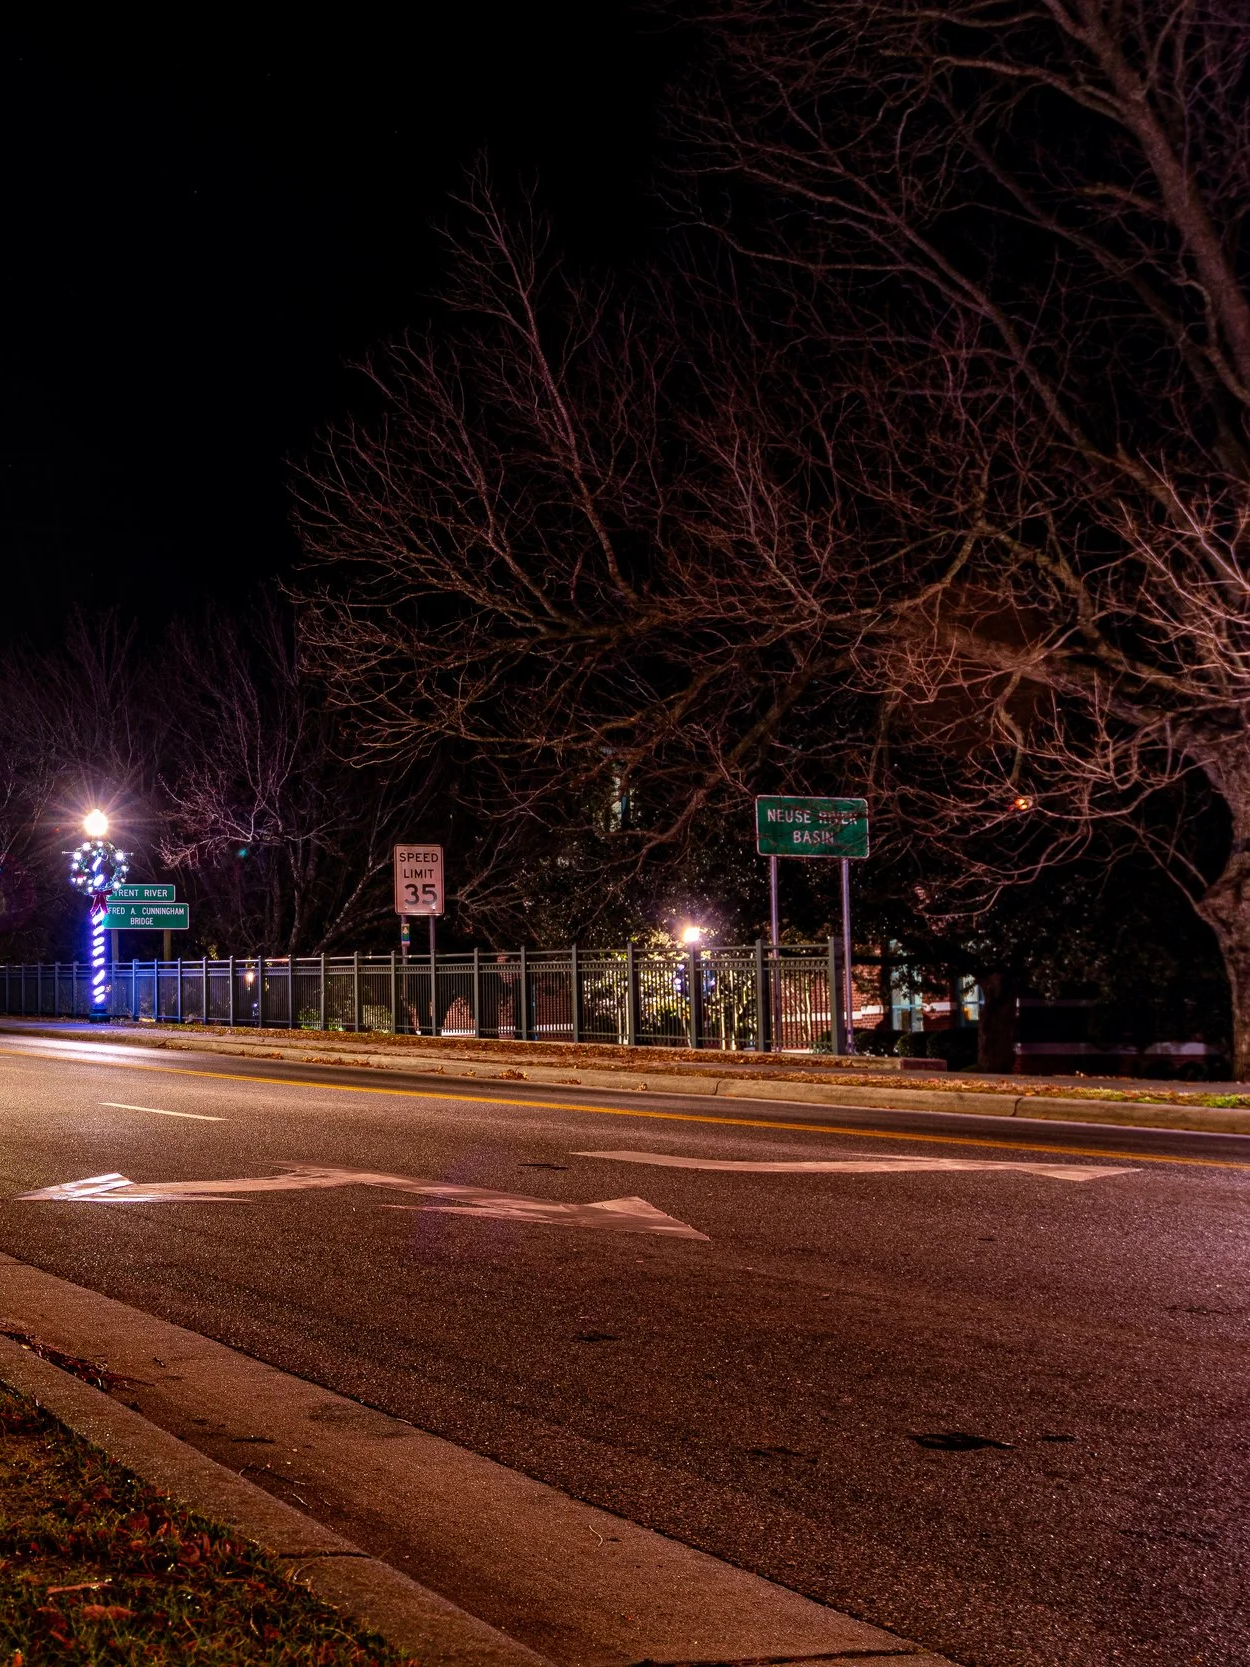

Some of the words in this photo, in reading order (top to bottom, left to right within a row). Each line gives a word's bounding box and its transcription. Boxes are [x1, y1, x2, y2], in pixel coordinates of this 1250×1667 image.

[767, 809, 811, 824] NEUSE
[793, 830, 834, 844] BASIN
[399, 852, 439, 863] SPEED
[403, 868, 435, 879] LIMIT
[144, 889, 168, 897] RIVER
[404, 883, 438, 905] 35
[108, 907, 126, 915] FRED
[141, 907, 185, 915] CUNNINGHAM
[130, 917, 154, 925] BRIDGE
